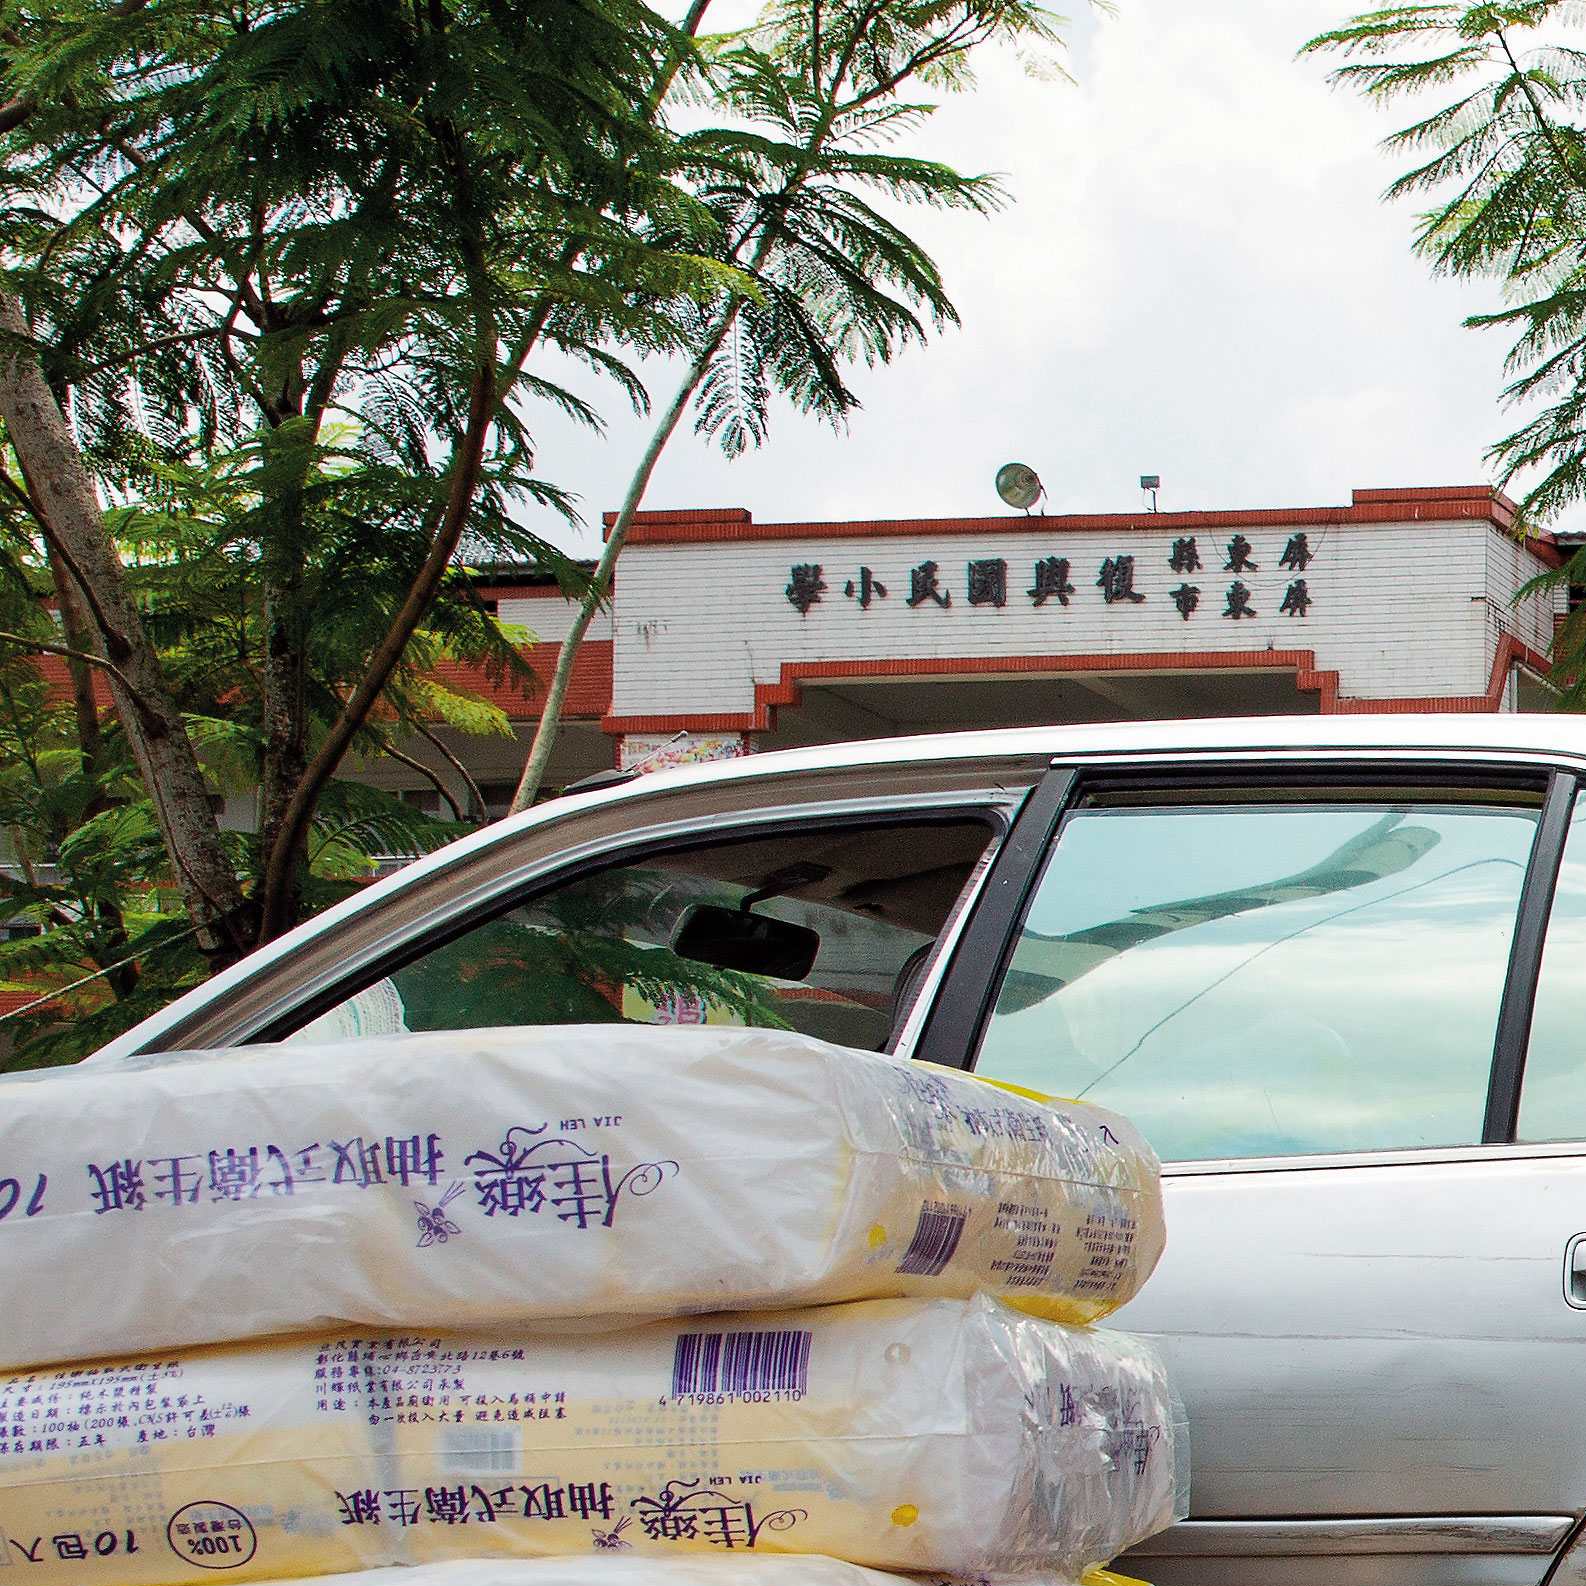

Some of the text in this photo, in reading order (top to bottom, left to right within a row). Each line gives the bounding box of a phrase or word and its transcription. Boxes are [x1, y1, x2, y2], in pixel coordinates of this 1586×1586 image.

[1168, 533, 1315, 573] 屏東縣
[1168, 579, 1313, 620] 屏東市
[560, 1113, 623, 1131] JIA LEH
[87, 1133, 446, 1214] 抽取式衛生紙
[464, 1140, 645, 1229] 佳樂
[658, 1390, 802, 1406] 4 719861 002110
[708, 1475, 761, 1487] JIA LEH
[334, 1480, 780, 1548] 佳樂 抽取式衛生紙
[189, 1536, 242, 1555] 100%
